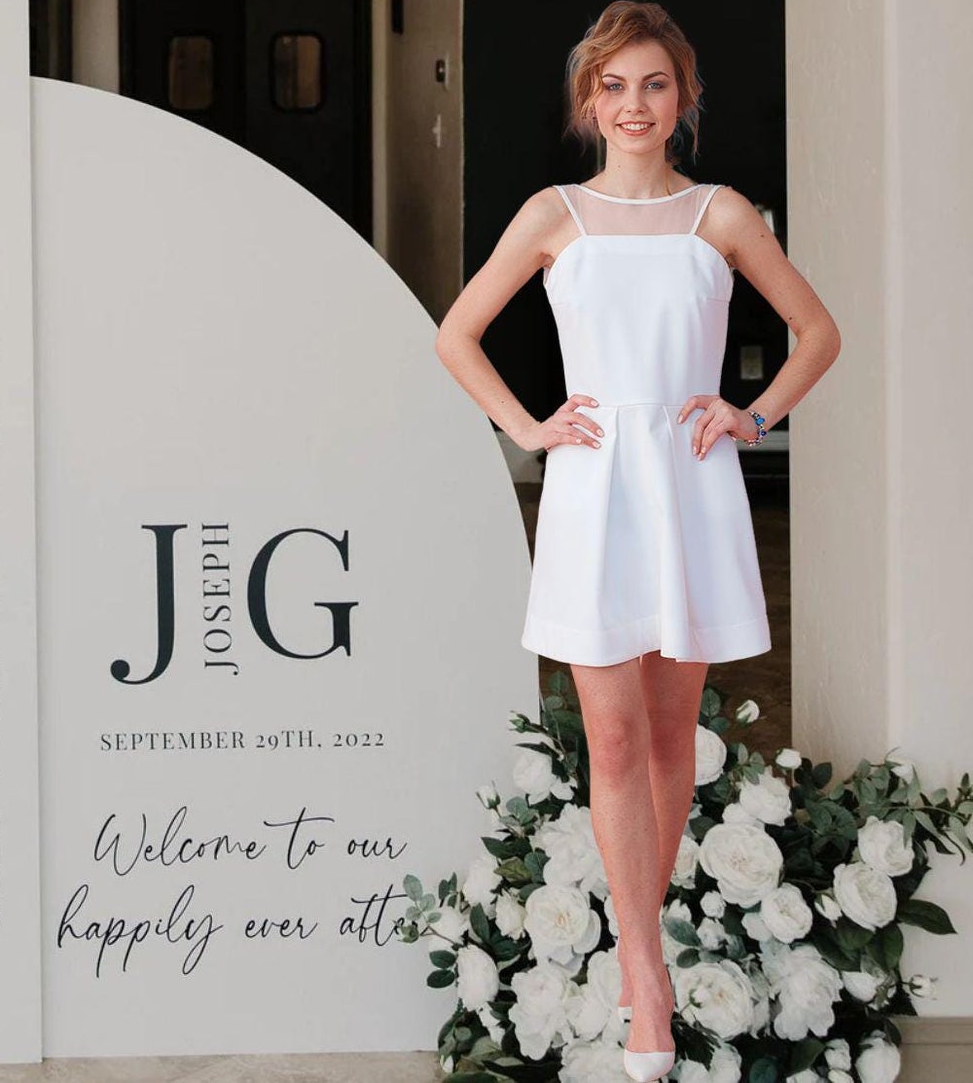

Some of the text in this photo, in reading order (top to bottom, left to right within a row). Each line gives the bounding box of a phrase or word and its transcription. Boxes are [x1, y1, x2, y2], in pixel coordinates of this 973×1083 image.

[110, 524, 187, 685] J
[202, 524, 238, 675] JOSEPH
[247, 528, 359, 659] G
[101, 730, 383, 750] SEPTEMBER 29TH, 2022
[94, 806, 407, 877] Welcome to our
[57, 884, 223, 978] happily
[245, 918, 317, 939] ever
